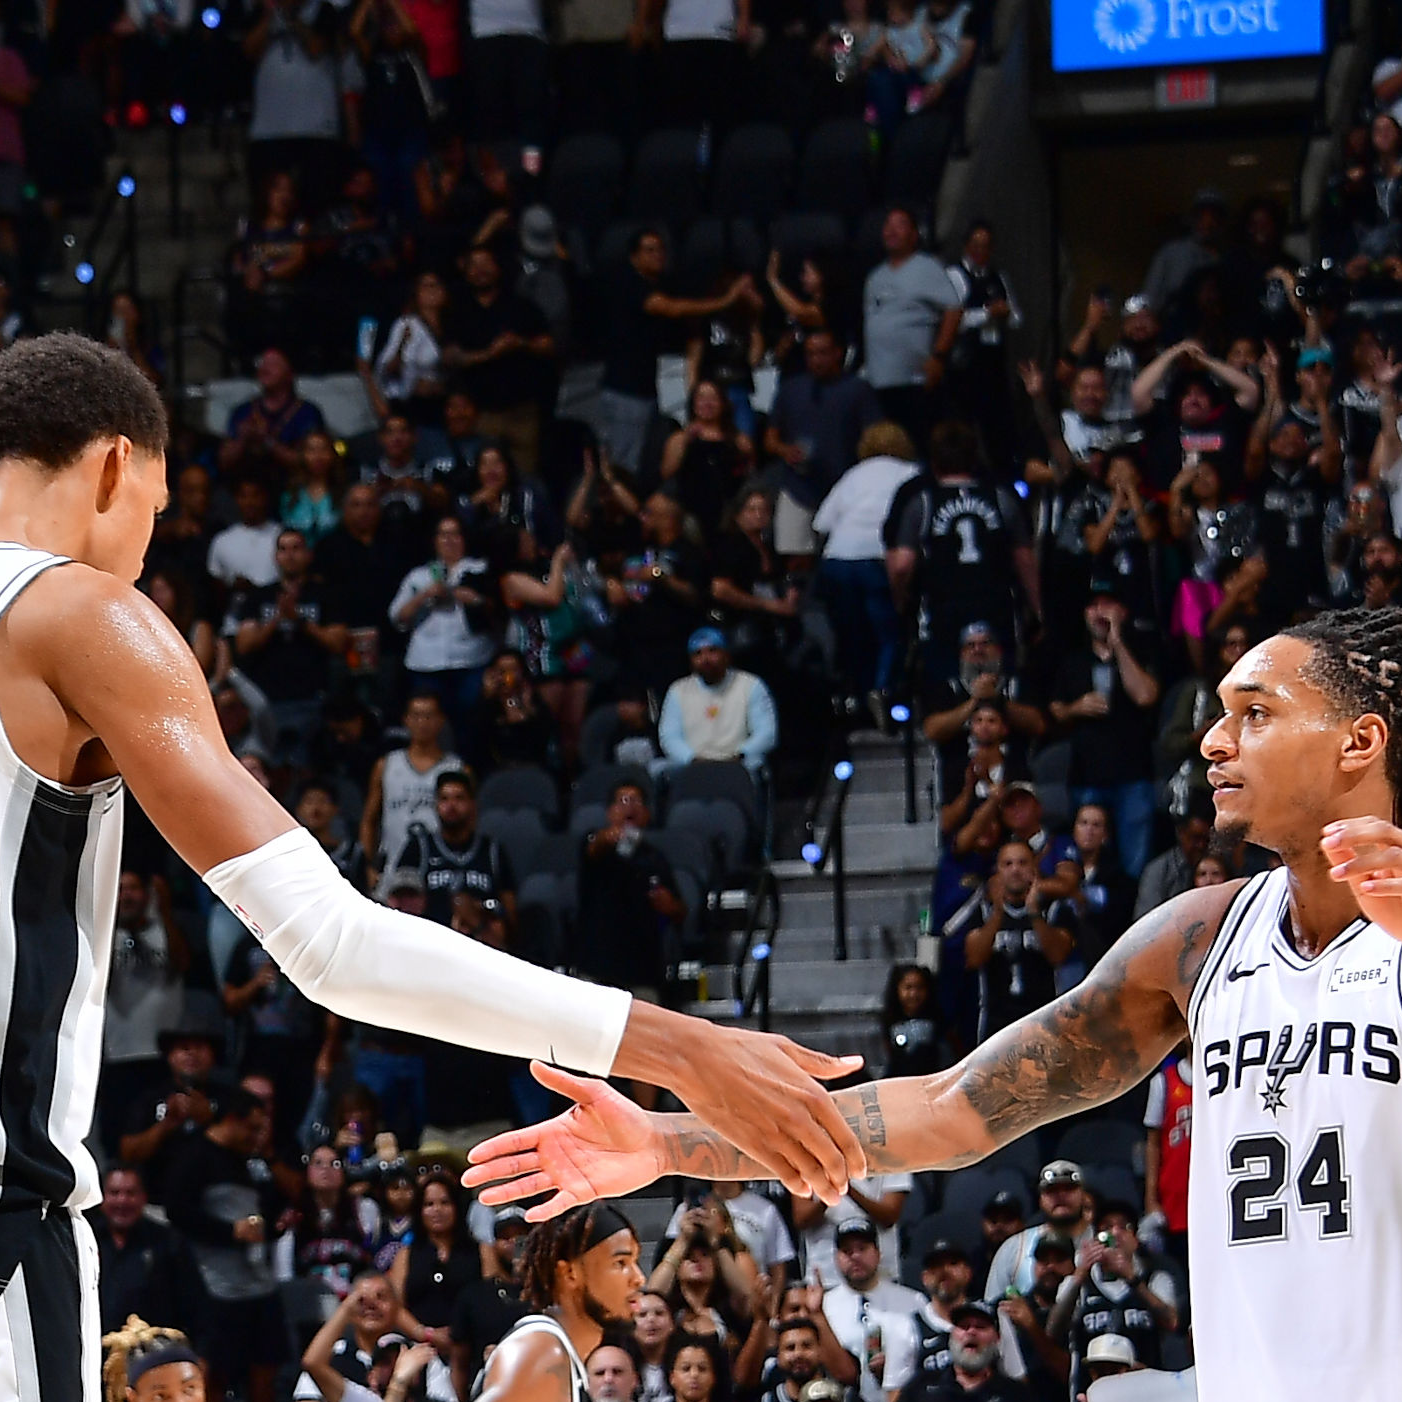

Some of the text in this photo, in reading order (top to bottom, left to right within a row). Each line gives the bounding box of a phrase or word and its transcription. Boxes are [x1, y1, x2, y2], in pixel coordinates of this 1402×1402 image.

[1168, 0, 1280, 38] Frost
[955, 517, 982, 564] 1
[1338, 967, 1383, 985] LEDGER
[1204, 1020, 1401, 1103] SPURS
[1226, 1125, 1353, 1247] 24
